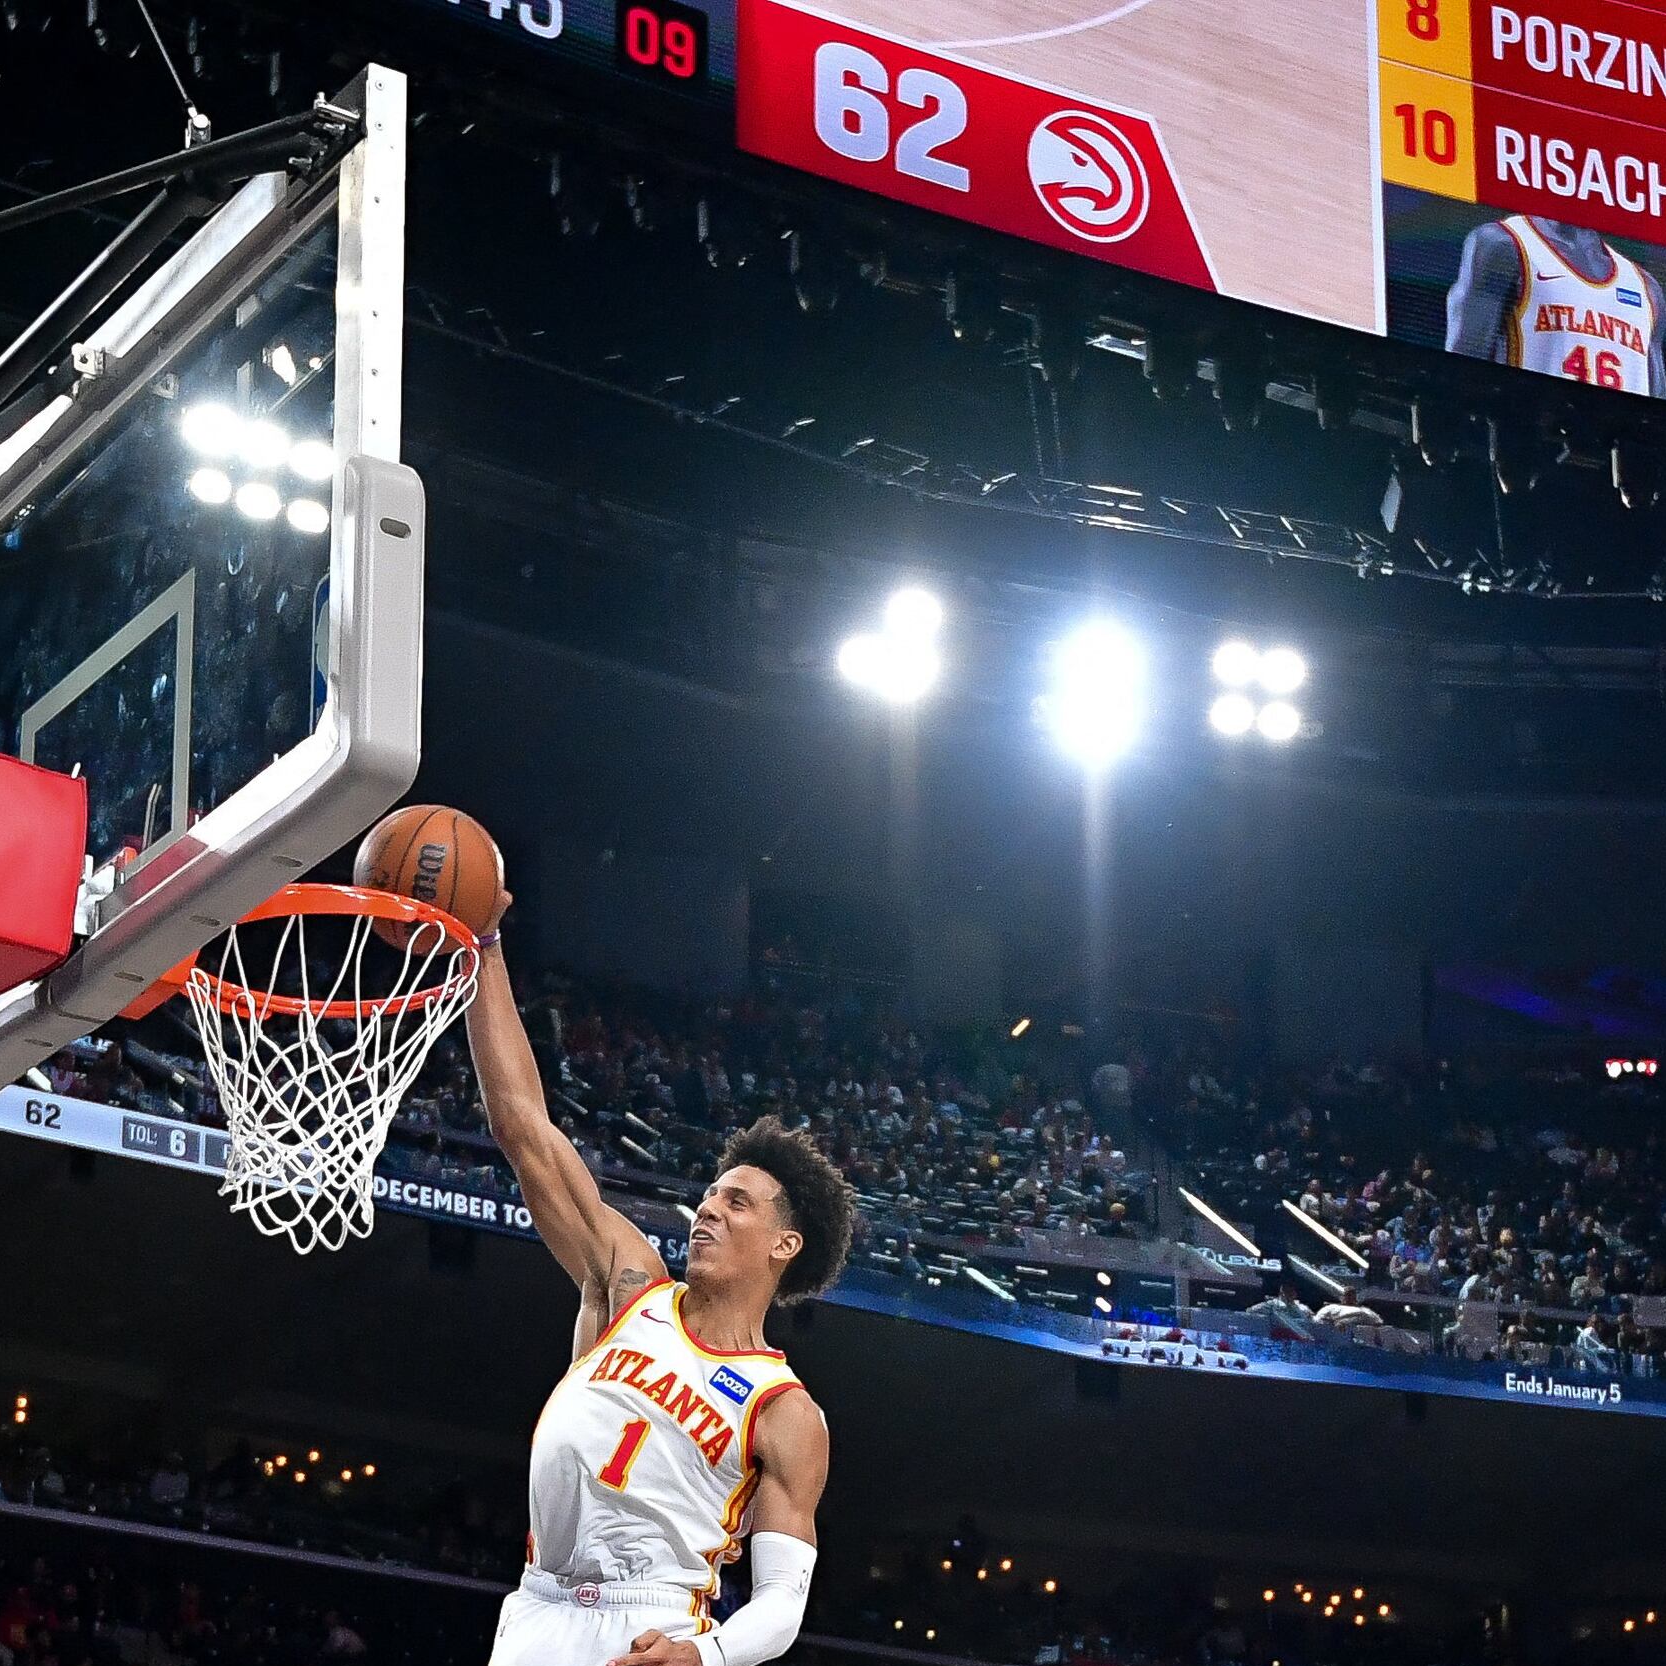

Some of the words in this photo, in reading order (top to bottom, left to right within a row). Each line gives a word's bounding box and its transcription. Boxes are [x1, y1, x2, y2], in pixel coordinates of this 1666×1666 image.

[626, 8, 695, 78] 09
[1406, 0, 1441, 41] 8
[814, 41, 970, 193] 62
[1394, 103, 1457, 167] 10
[1533, 302, 1647, 356] ATLANTA
[1562, 343, 1623, 393] 46
[25, 1099, 62, 1130] 62
[128, 1123, 158, 1147] TOL:
[169, 1129, 187, 1157] 6
[373, 1175, 497, 1223] DECEMBER
[1219, 1253, 1282, 1272] LEXUS
[589, 1348, 735, 1468] ATLANTA
[713, 1371, 749, 1398] paze
[1505, 1372, 1543, 1395] Ends
[1546, 1378, 1607, 1405] January
[1609, 1383, 1622, 1404] 5
[599, 1418, 651, 1492] 1
